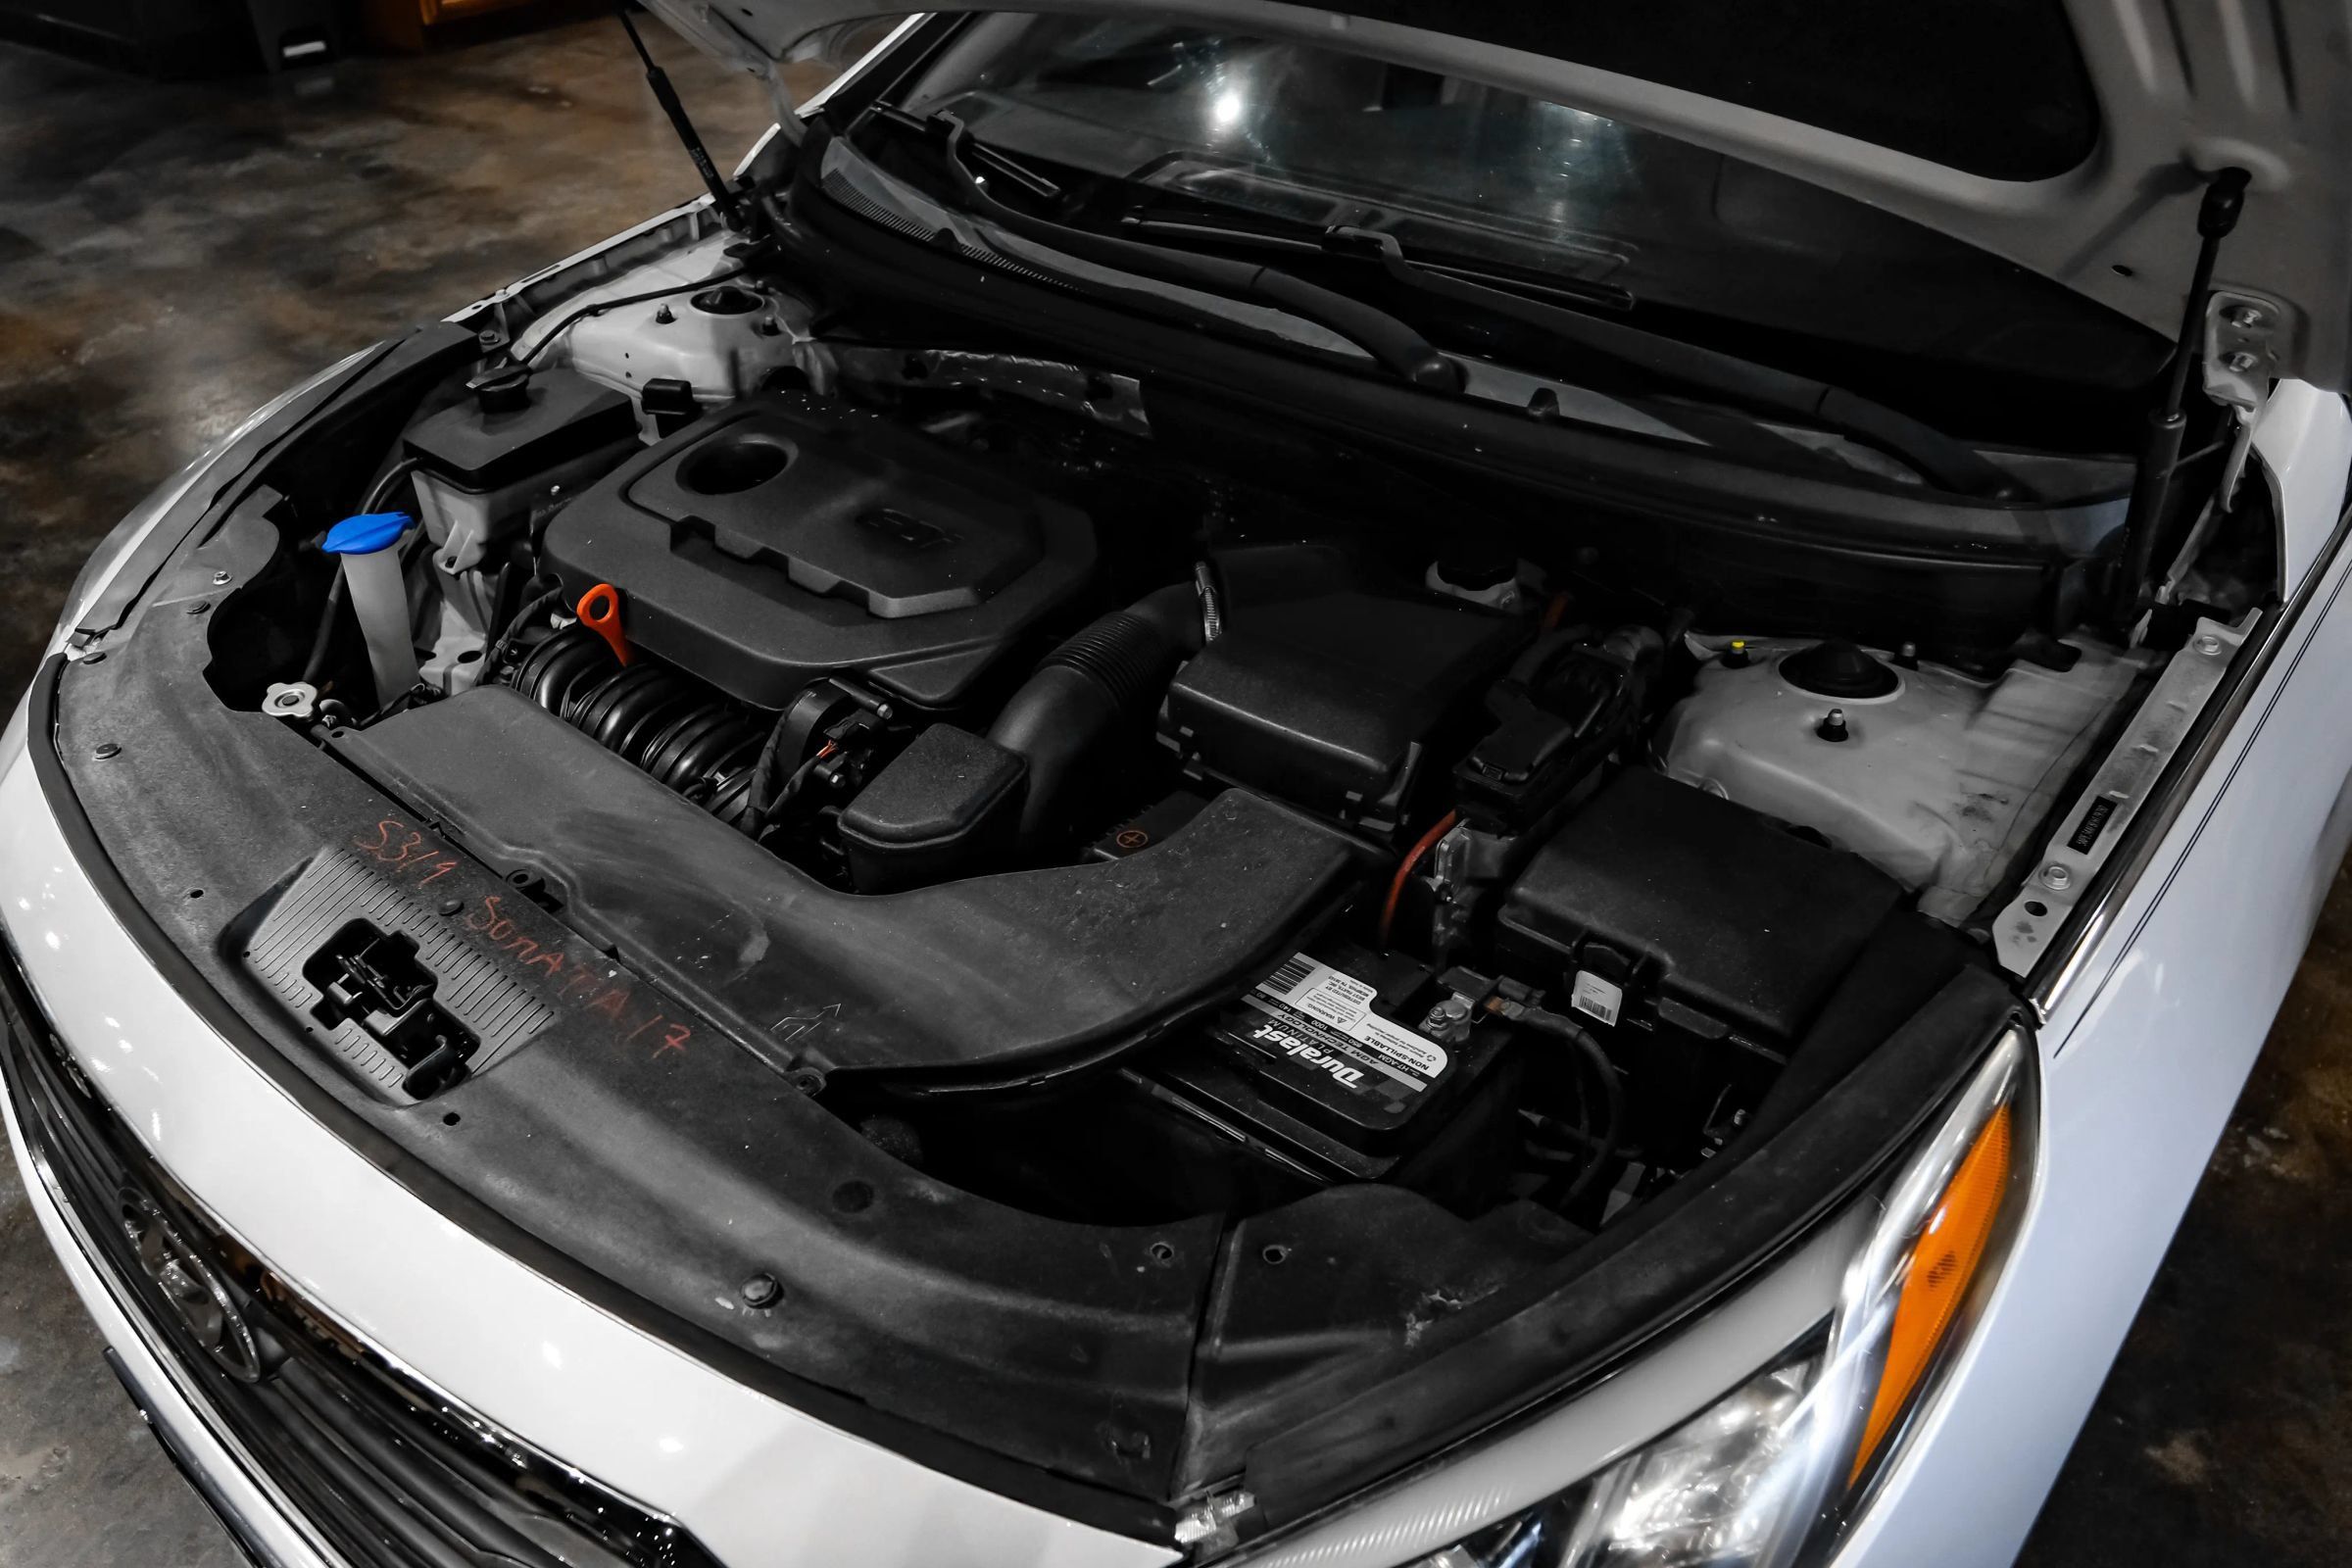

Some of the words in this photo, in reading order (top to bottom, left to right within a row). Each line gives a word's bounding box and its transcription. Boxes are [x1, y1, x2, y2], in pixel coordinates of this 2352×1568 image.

[1278, 1003, 1292, 1012] 140
[1267, 1019, 1335, 1054] PLATINUM
[1277, 1013, 1349, 1052] TECHNOLOGY
[1310, 1019, 1328, 1031] 1000
[1252, 1024, 1365, 1089] Duralast
[1349, 1050, 1379, 1064] AGM
[1364, 1035, 1430, 1071] NON-SPILLABLE
[1378, 1054, 1410, 1072] H7-AGM
